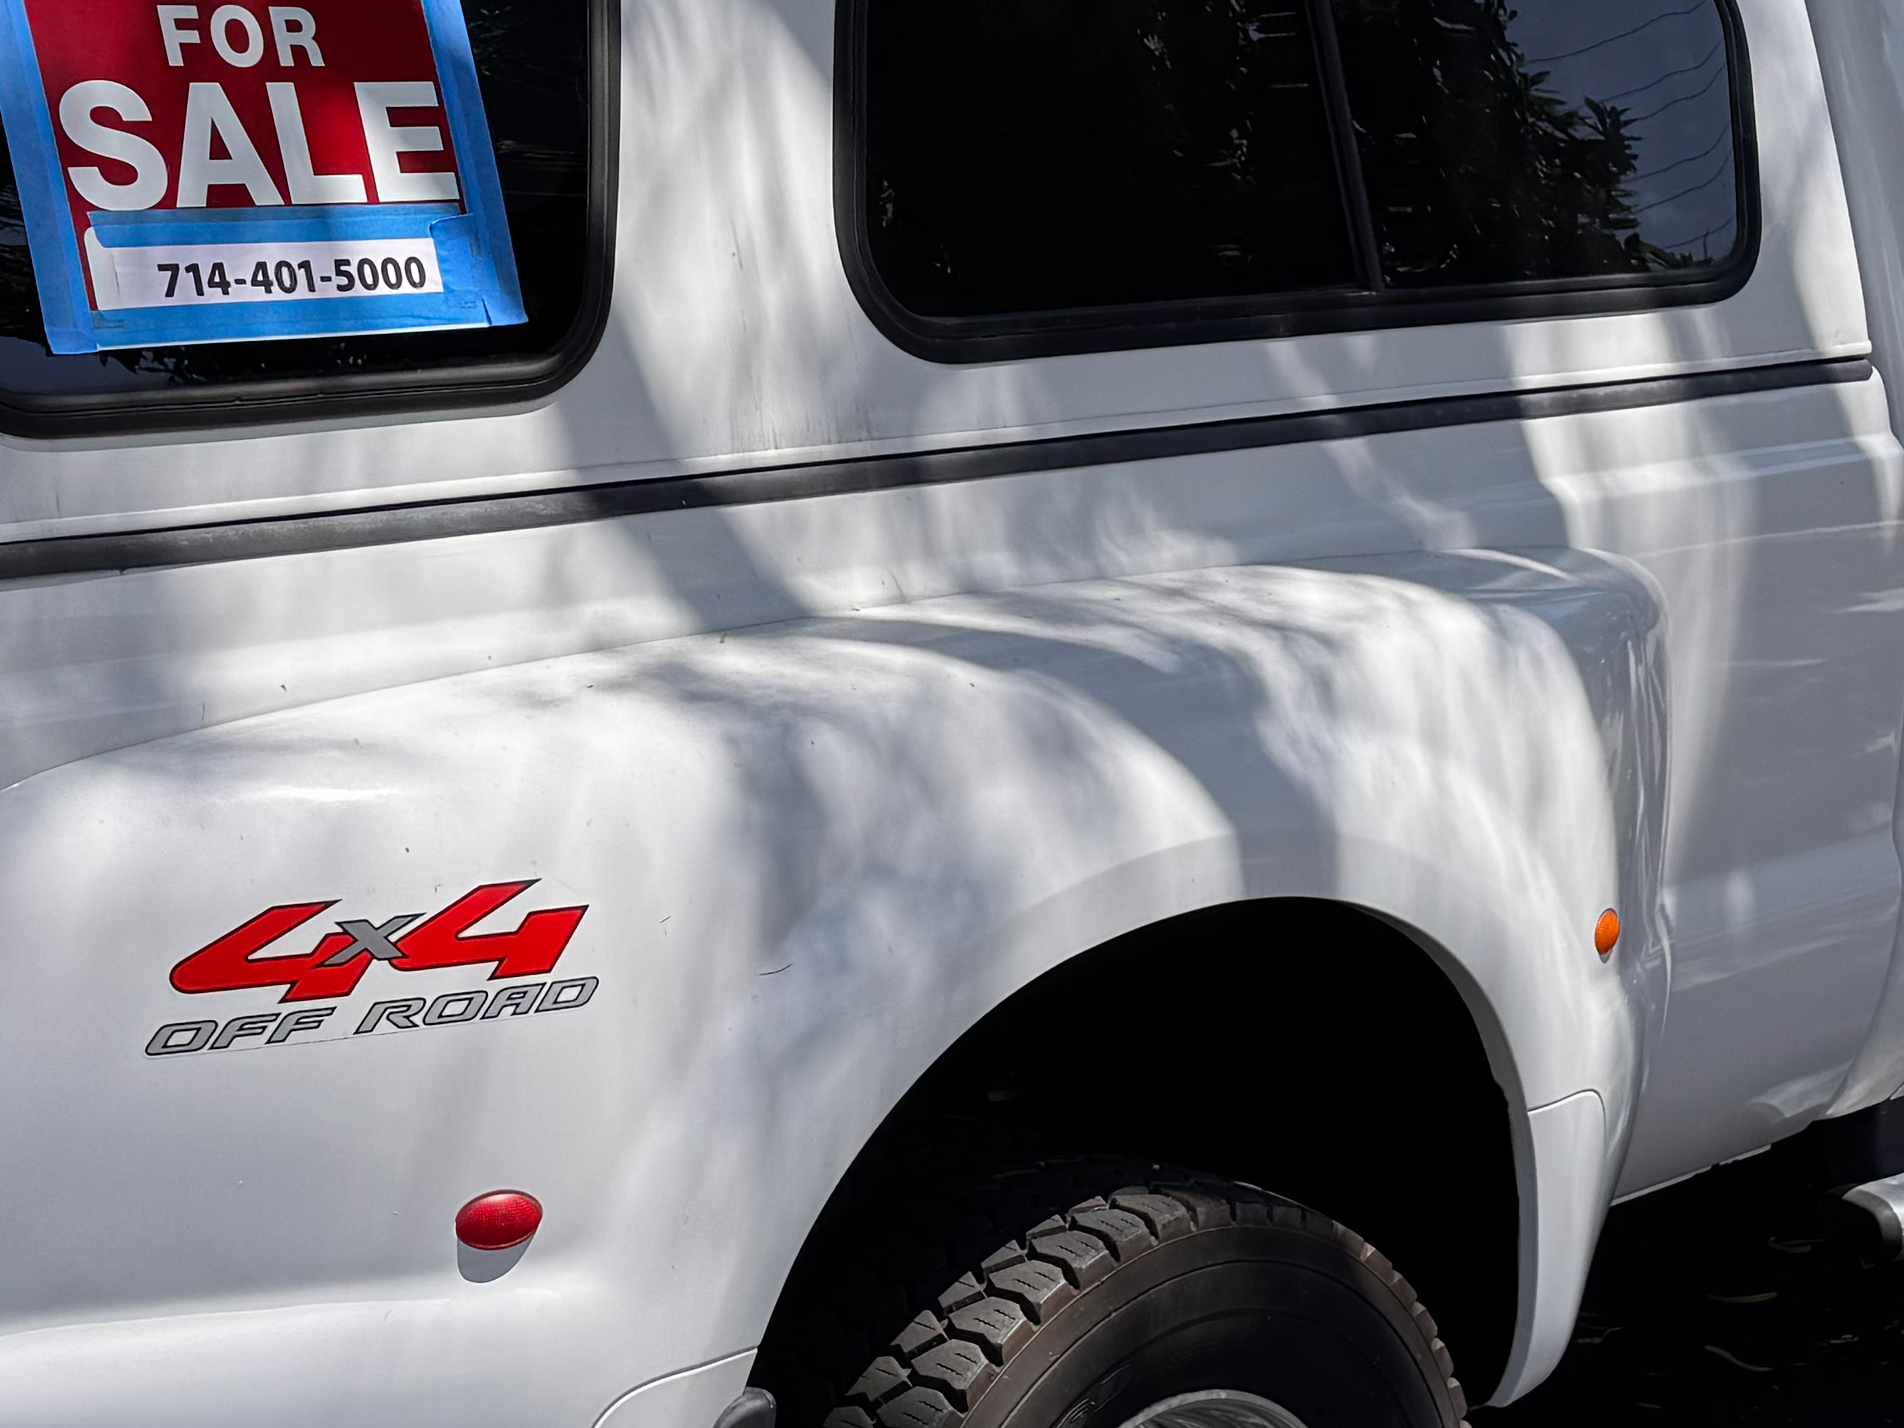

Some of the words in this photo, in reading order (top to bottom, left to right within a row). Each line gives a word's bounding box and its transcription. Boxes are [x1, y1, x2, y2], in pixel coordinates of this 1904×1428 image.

[156, 4, 326, 68] FOR
[58, 80, 460, 212] SALE
[156, 255, 427, 299] 714-401-5000
[144, 1006, 337, 1057] OFF
[353, 975, 600, 1036] ROAD
